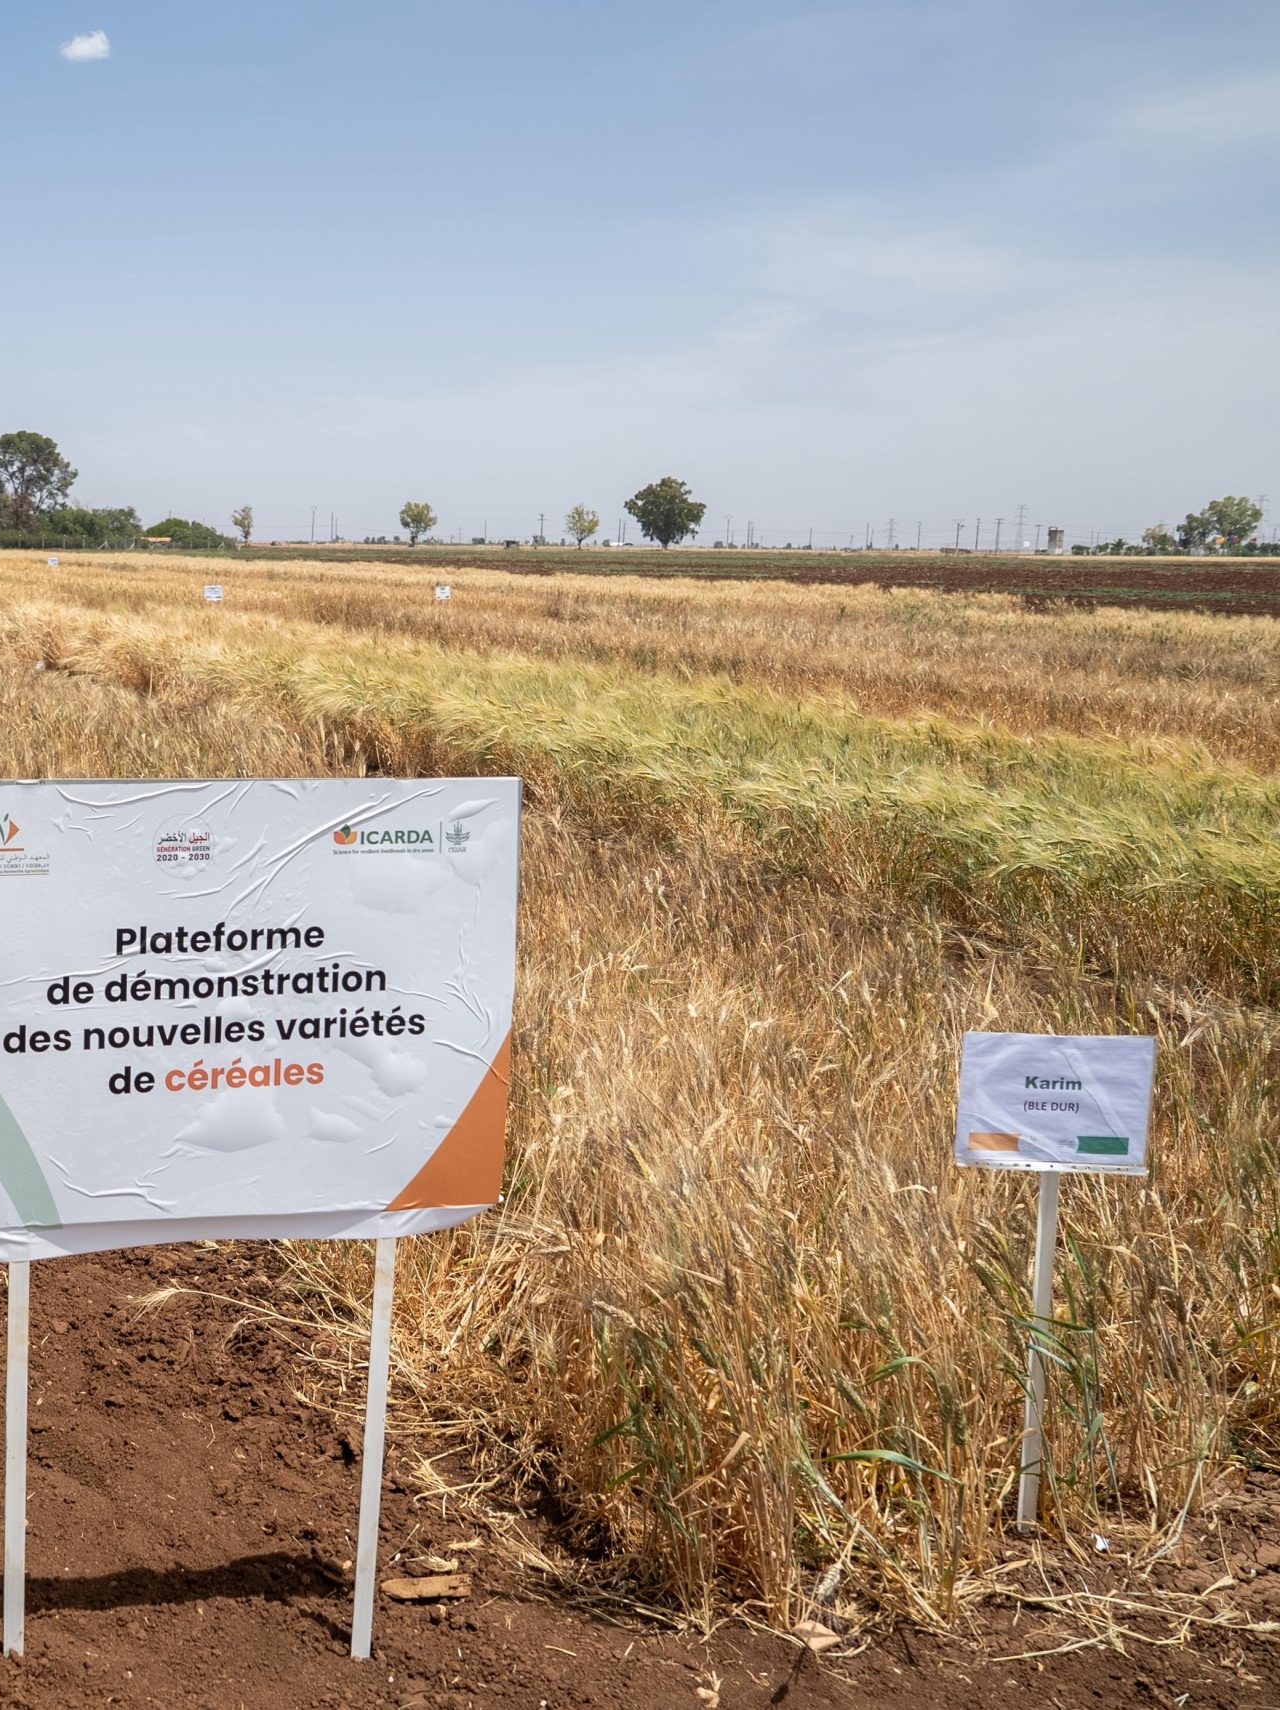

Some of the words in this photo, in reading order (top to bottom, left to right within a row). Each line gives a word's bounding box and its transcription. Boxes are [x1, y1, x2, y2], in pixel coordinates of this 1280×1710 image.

[156, 830, 187, 845] الأخضر
[189, 832, 210, 844] الجيل
[360, 830, 433, 845] ICARDA
[156, 854, 179, 862] 2020
[188, 853, 210, 861] 2030
[117, 922, 324, 955] Plateforme
[47, 976, 93, 1004] de
[105, 963, 385, 1002] démonstration
[4, 1025, 71, 1053] des
[84, 1016, 264, 1049] nouvelles
[276, 1006, 424, 1040] variétés
[109, 1066, 154, 1094] de
[165, 1058, 324, 1092] céréales
[1024, 1075, 1083, 1091] Karim
[1023, 1100, 1048, 1112] (BLE
[1050, 1101, 1080, 1114] DUR)
